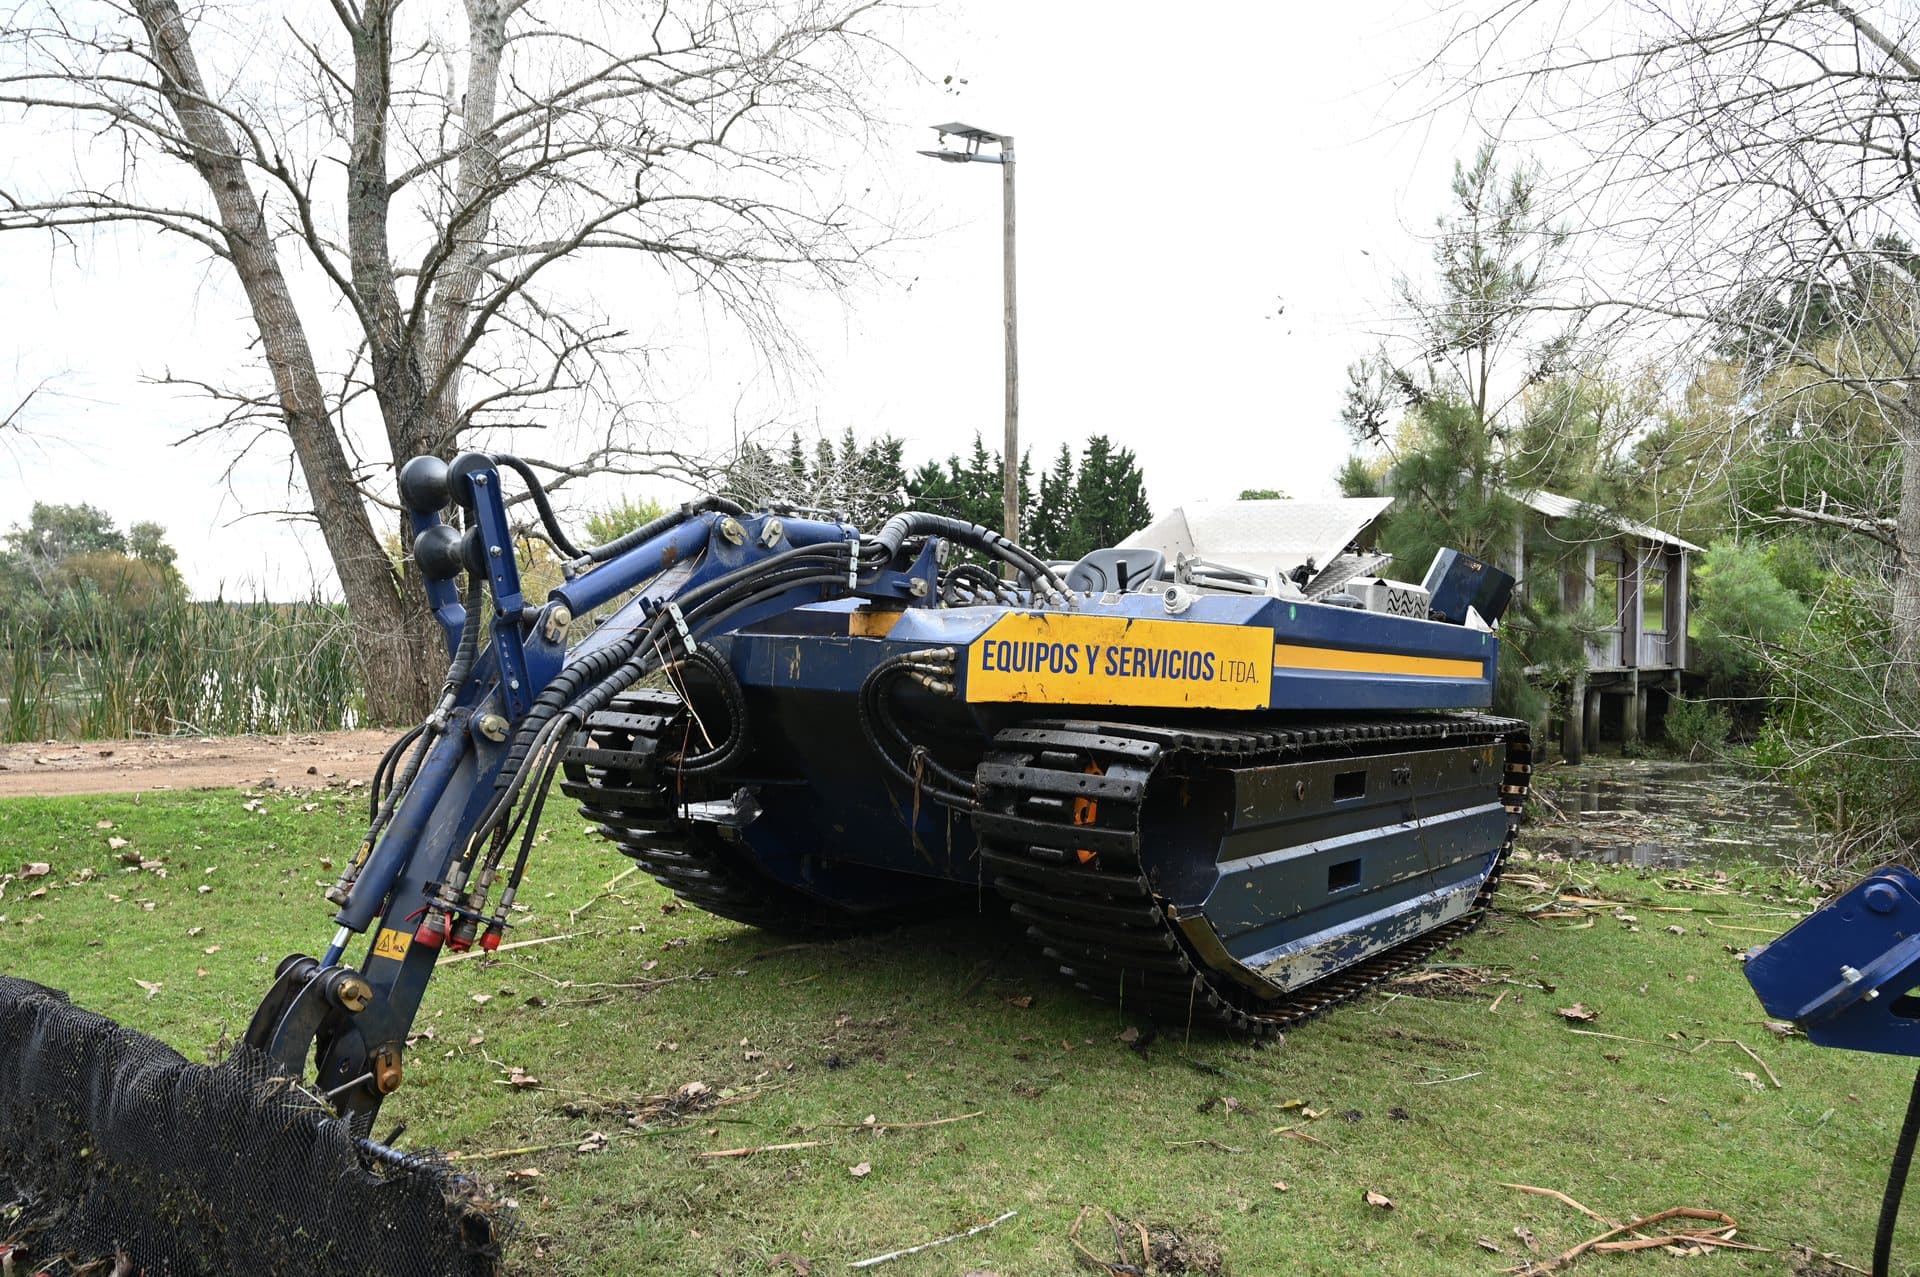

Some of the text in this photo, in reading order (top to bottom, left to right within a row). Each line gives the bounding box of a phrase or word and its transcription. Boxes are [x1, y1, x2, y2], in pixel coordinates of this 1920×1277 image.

[982, 640, 1259, 684] EQUIPOS Y SERVICIOS LTDA.
